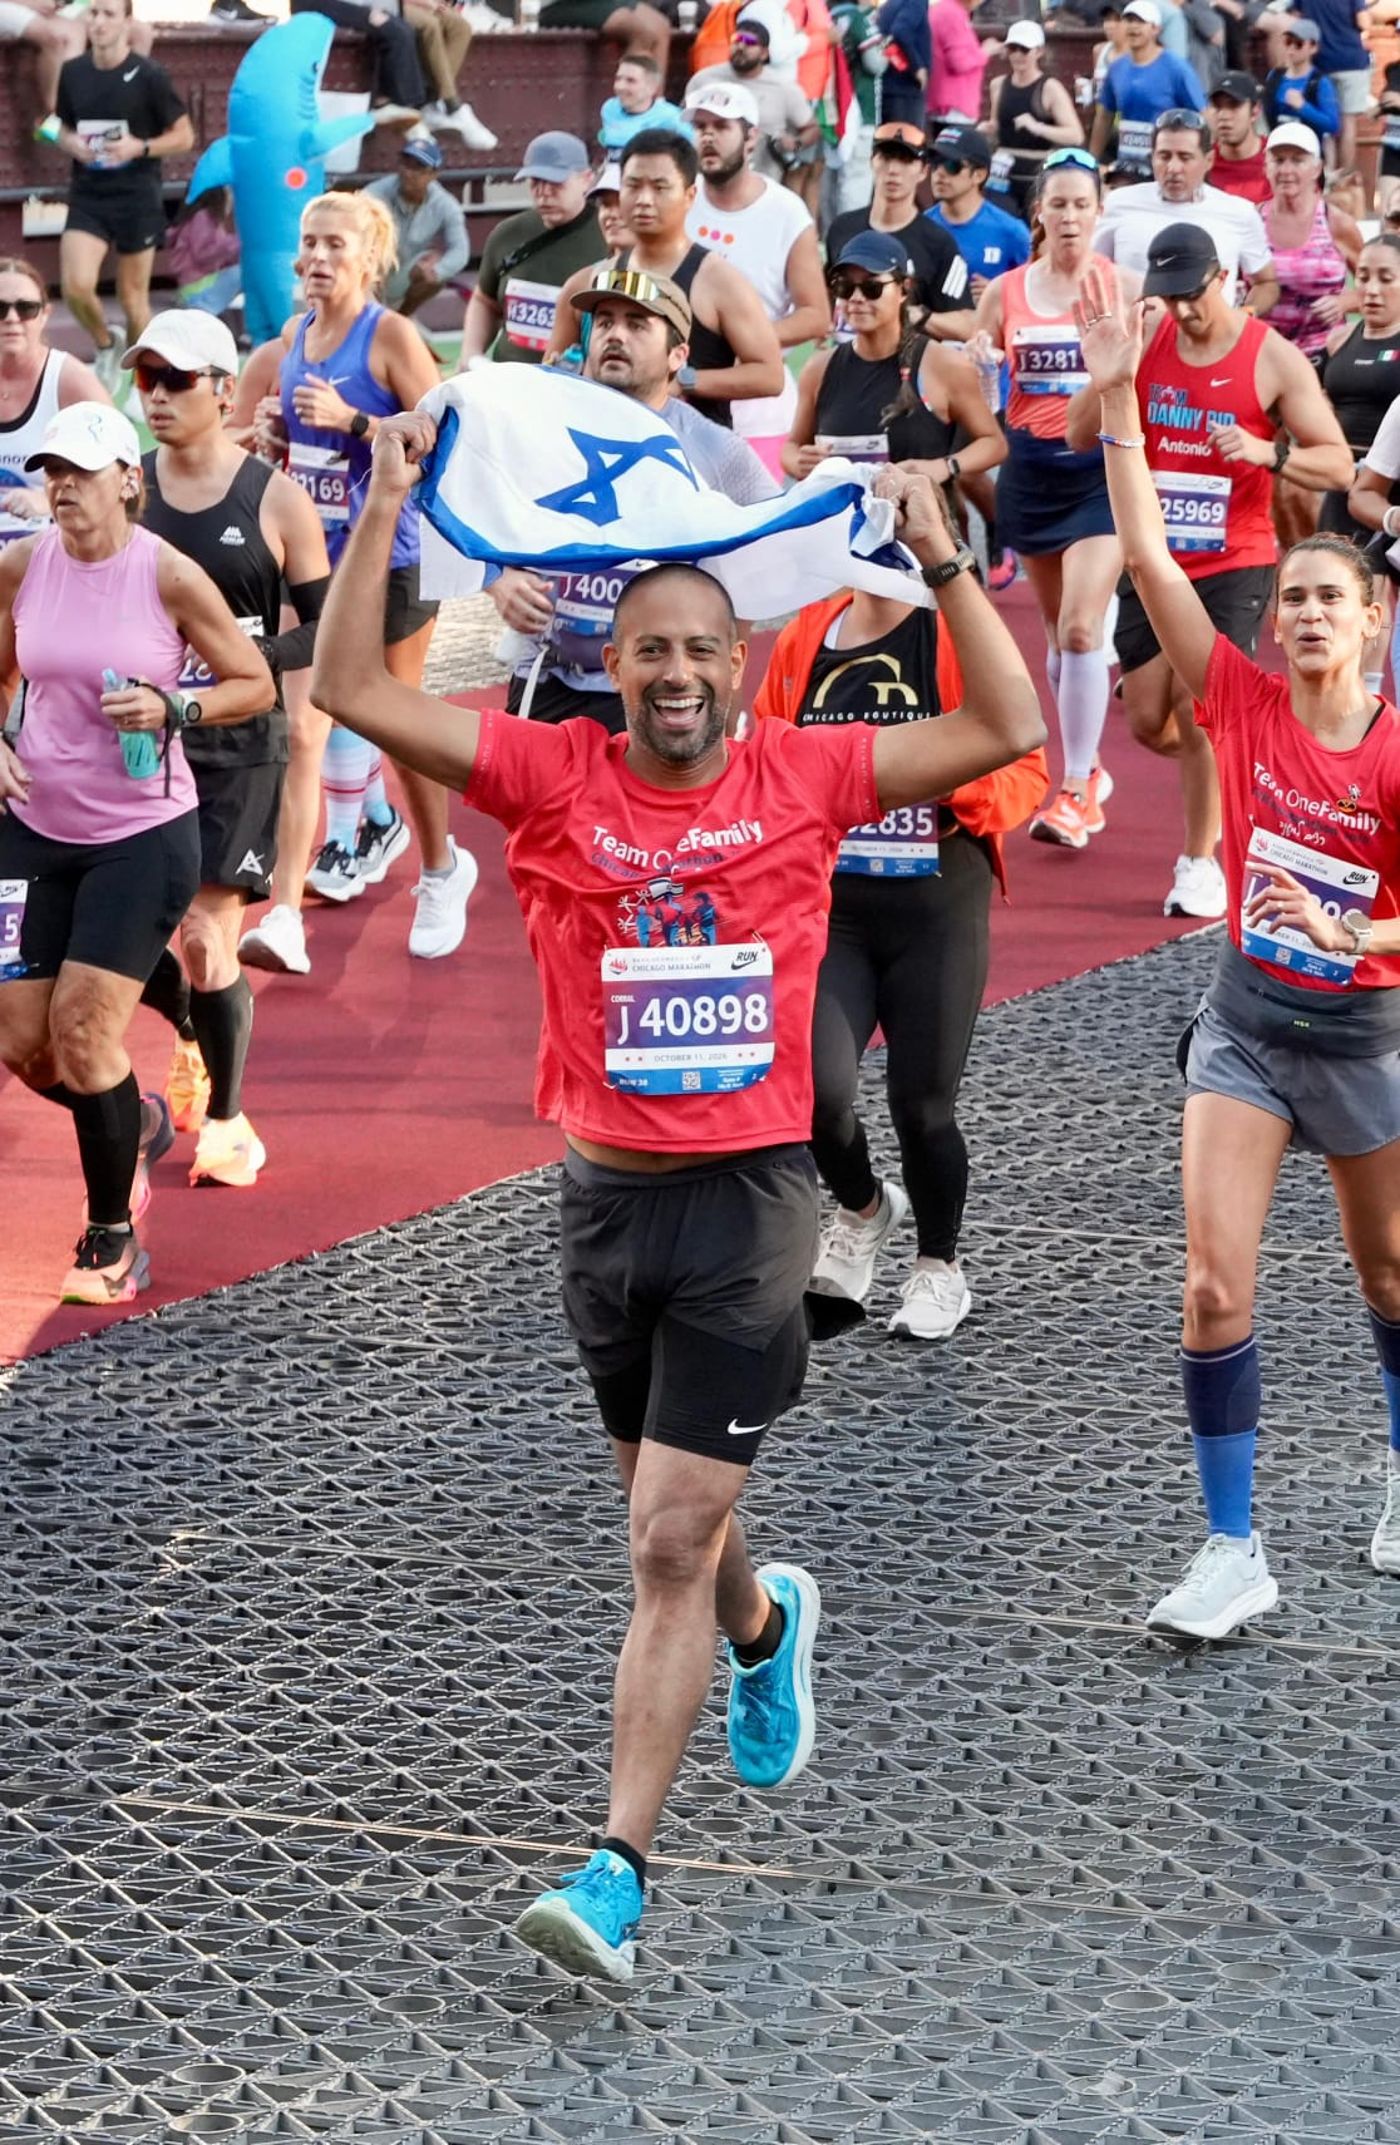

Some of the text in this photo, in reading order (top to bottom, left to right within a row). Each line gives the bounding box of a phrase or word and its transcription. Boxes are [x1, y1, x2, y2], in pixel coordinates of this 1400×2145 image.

[1148, 401, 1204, 431] DANNY
[1157, 435, 1213, 455] Antonio
[1160, 497, 1226, 523] 25969
[803, 711, 854, 722] CHICAGO
[1286, 789, 1381, 836] OneFamily
[592, 819, 764, 872] Team OeFamily
[1348, 871, 1369, 883] RUN
[736, 950, 759, 961] RUN
[617, 993, 768, 1045] J 40898
